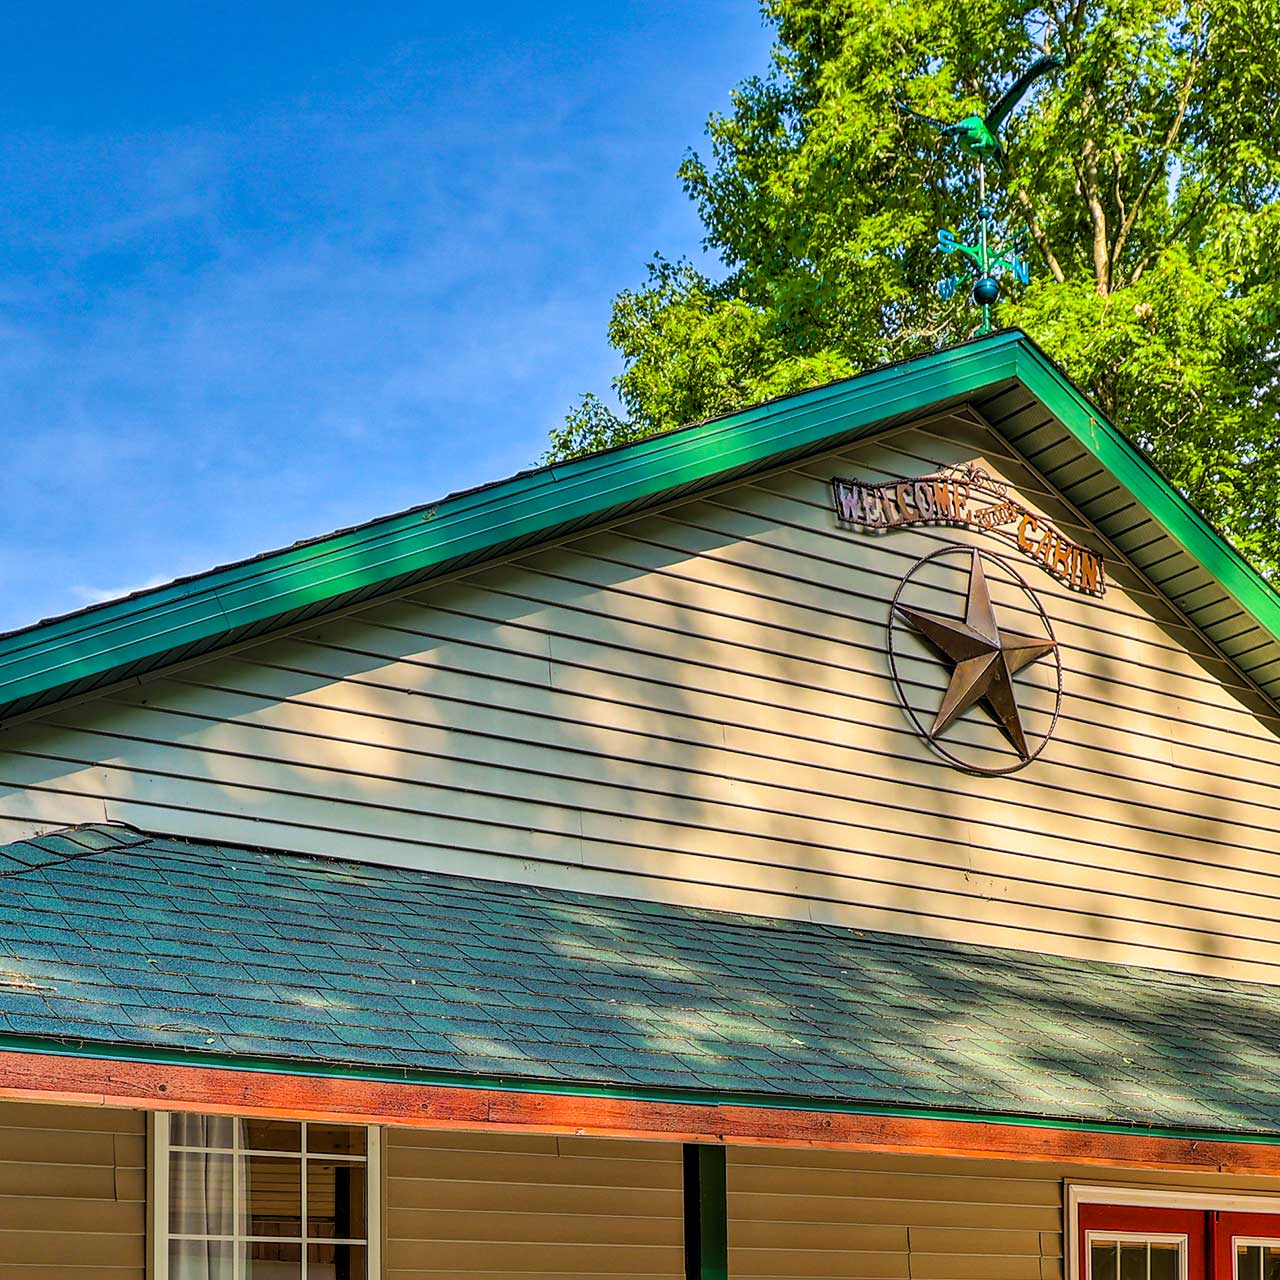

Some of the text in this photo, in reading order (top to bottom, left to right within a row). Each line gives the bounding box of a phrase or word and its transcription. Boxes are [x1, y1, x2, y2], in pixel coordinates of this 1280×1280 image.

[1012, 256, 1030, 285] N
[838, 481, 972, 526] WELCOME
[1017, 514, 1100, 591] CABIN
